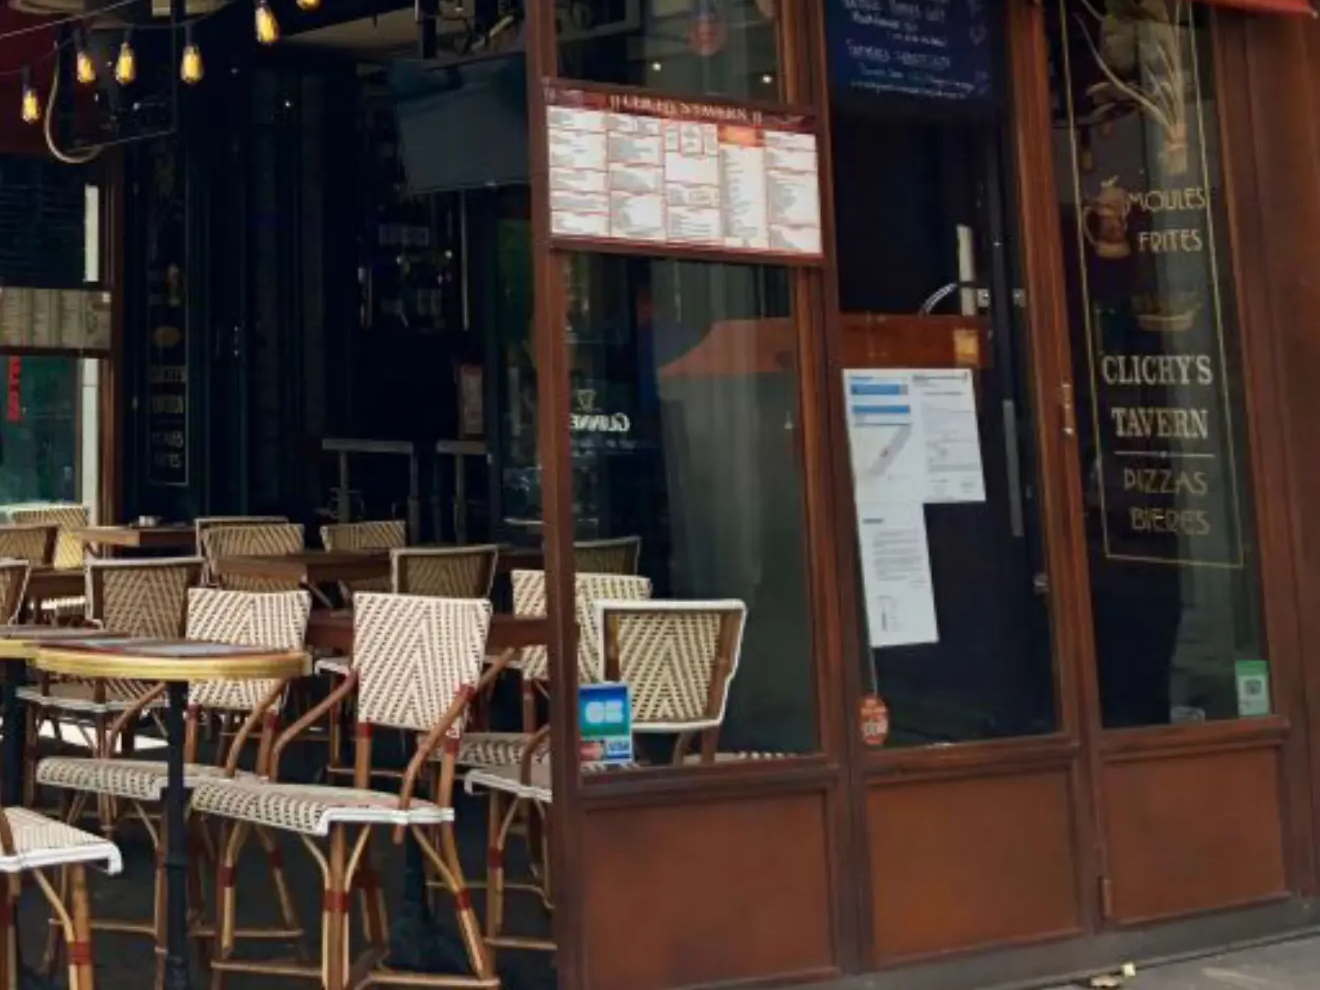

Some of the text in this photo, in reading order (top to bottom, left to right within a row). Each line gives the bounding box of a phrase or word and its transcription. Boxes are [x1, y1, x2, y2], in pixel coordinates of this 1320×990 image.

[1122, 188, 1206, 218] MOULES
[1139, 229, 1203, 253] FRITES
[1101, 354, 1214, 386] CLICHY'S
[1110, 407, 1209, 439] TAVERN
[1123, 467, 1208, 496] PIZZAS
[1130, 506, 1211, 536] BIERES
